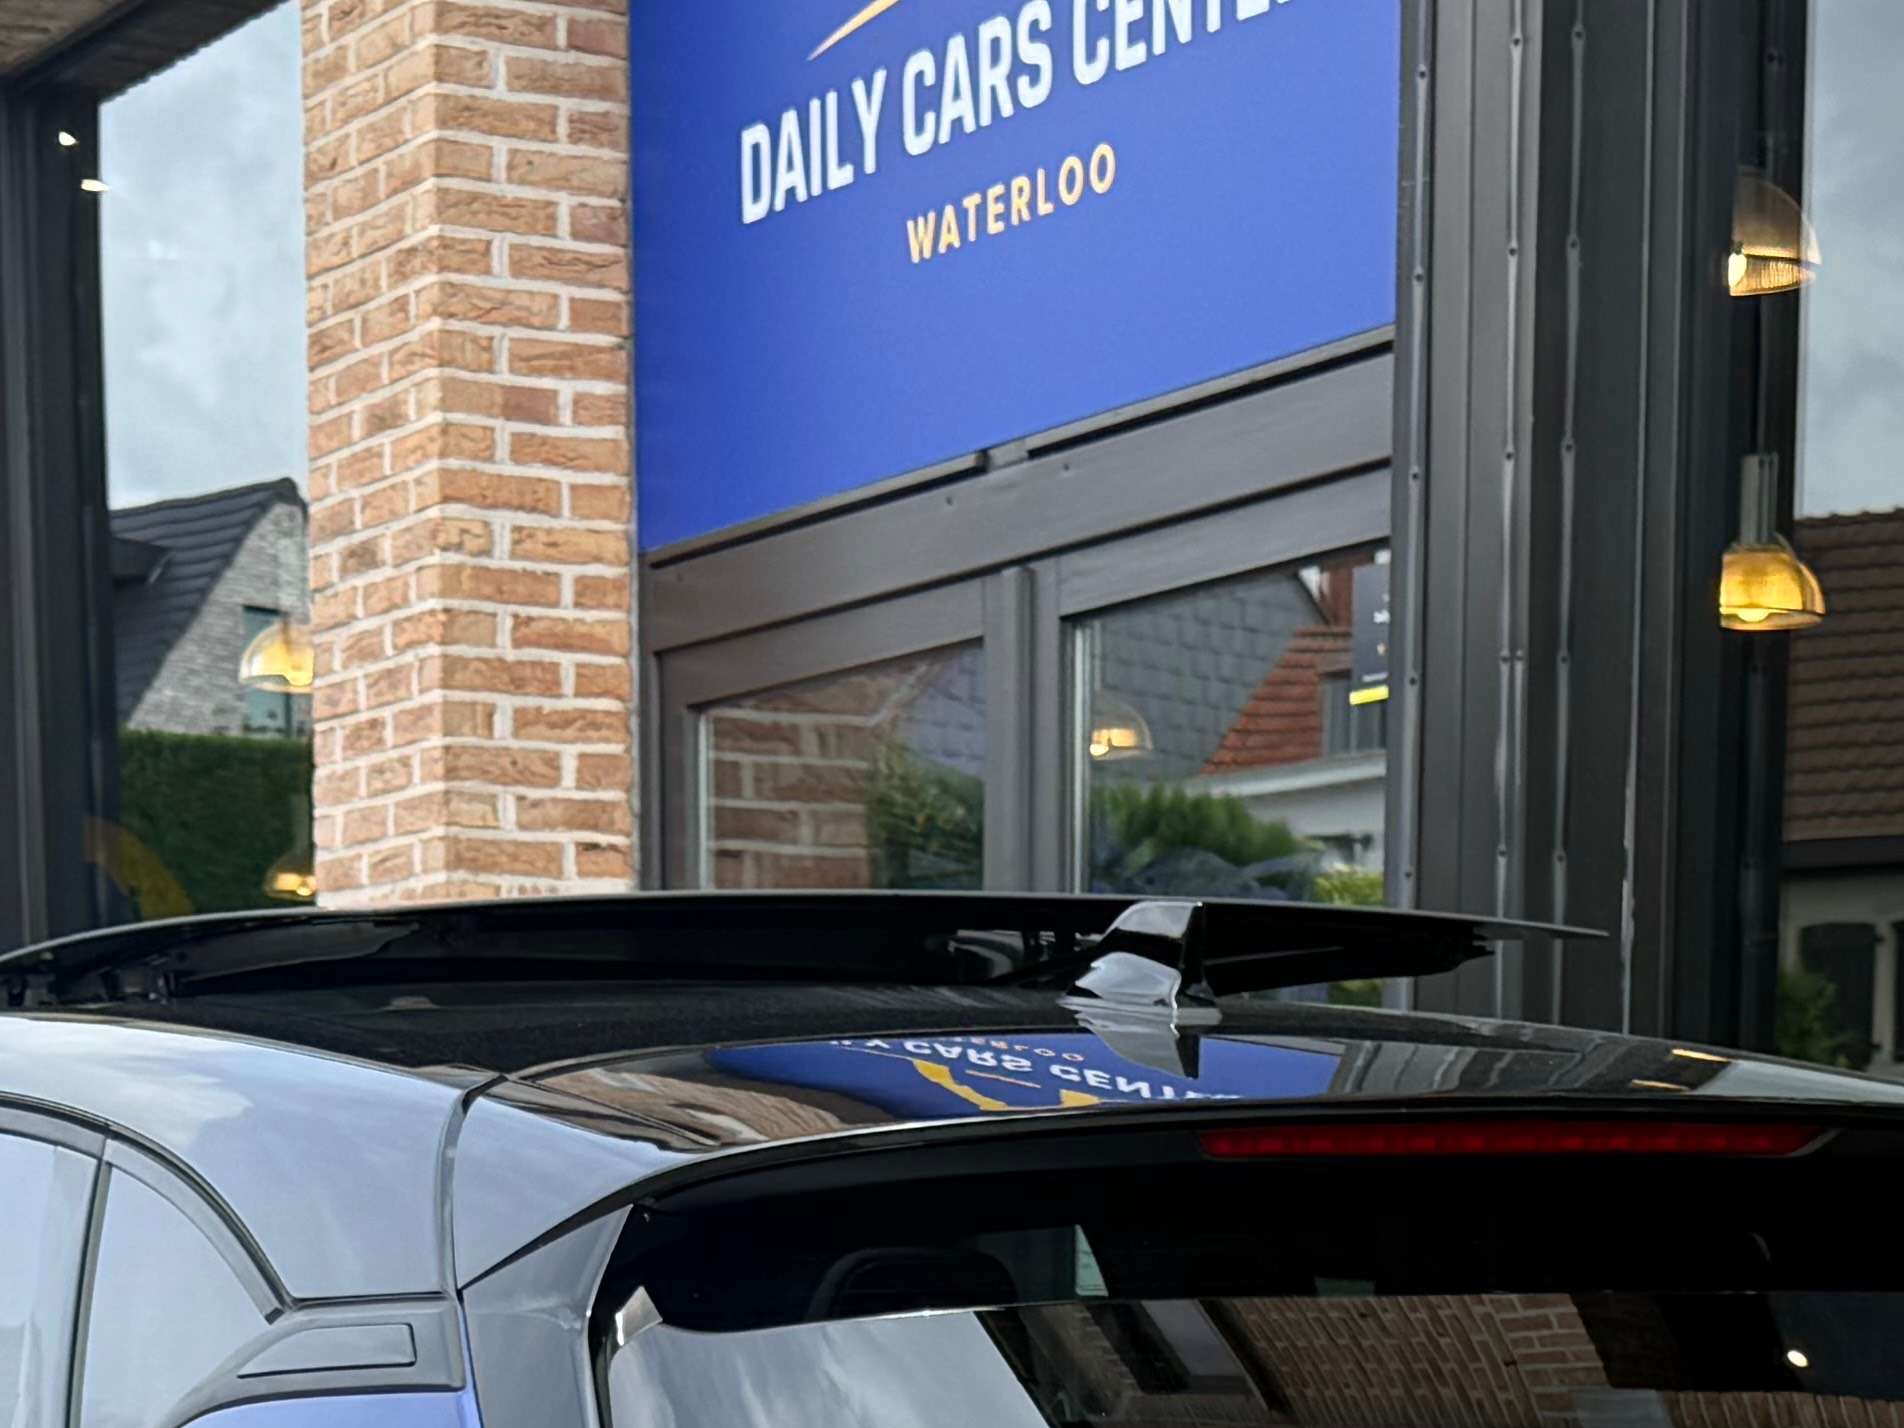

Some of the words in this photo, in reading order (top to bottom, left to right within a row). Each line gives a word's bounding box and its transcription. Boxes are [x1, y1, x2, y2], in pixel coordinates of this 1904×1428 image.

[741, 66, 888, 225] DAILY
[902, 0, 1053, 156] CARS
[906, 143, 1117, 264] WATERLOO
